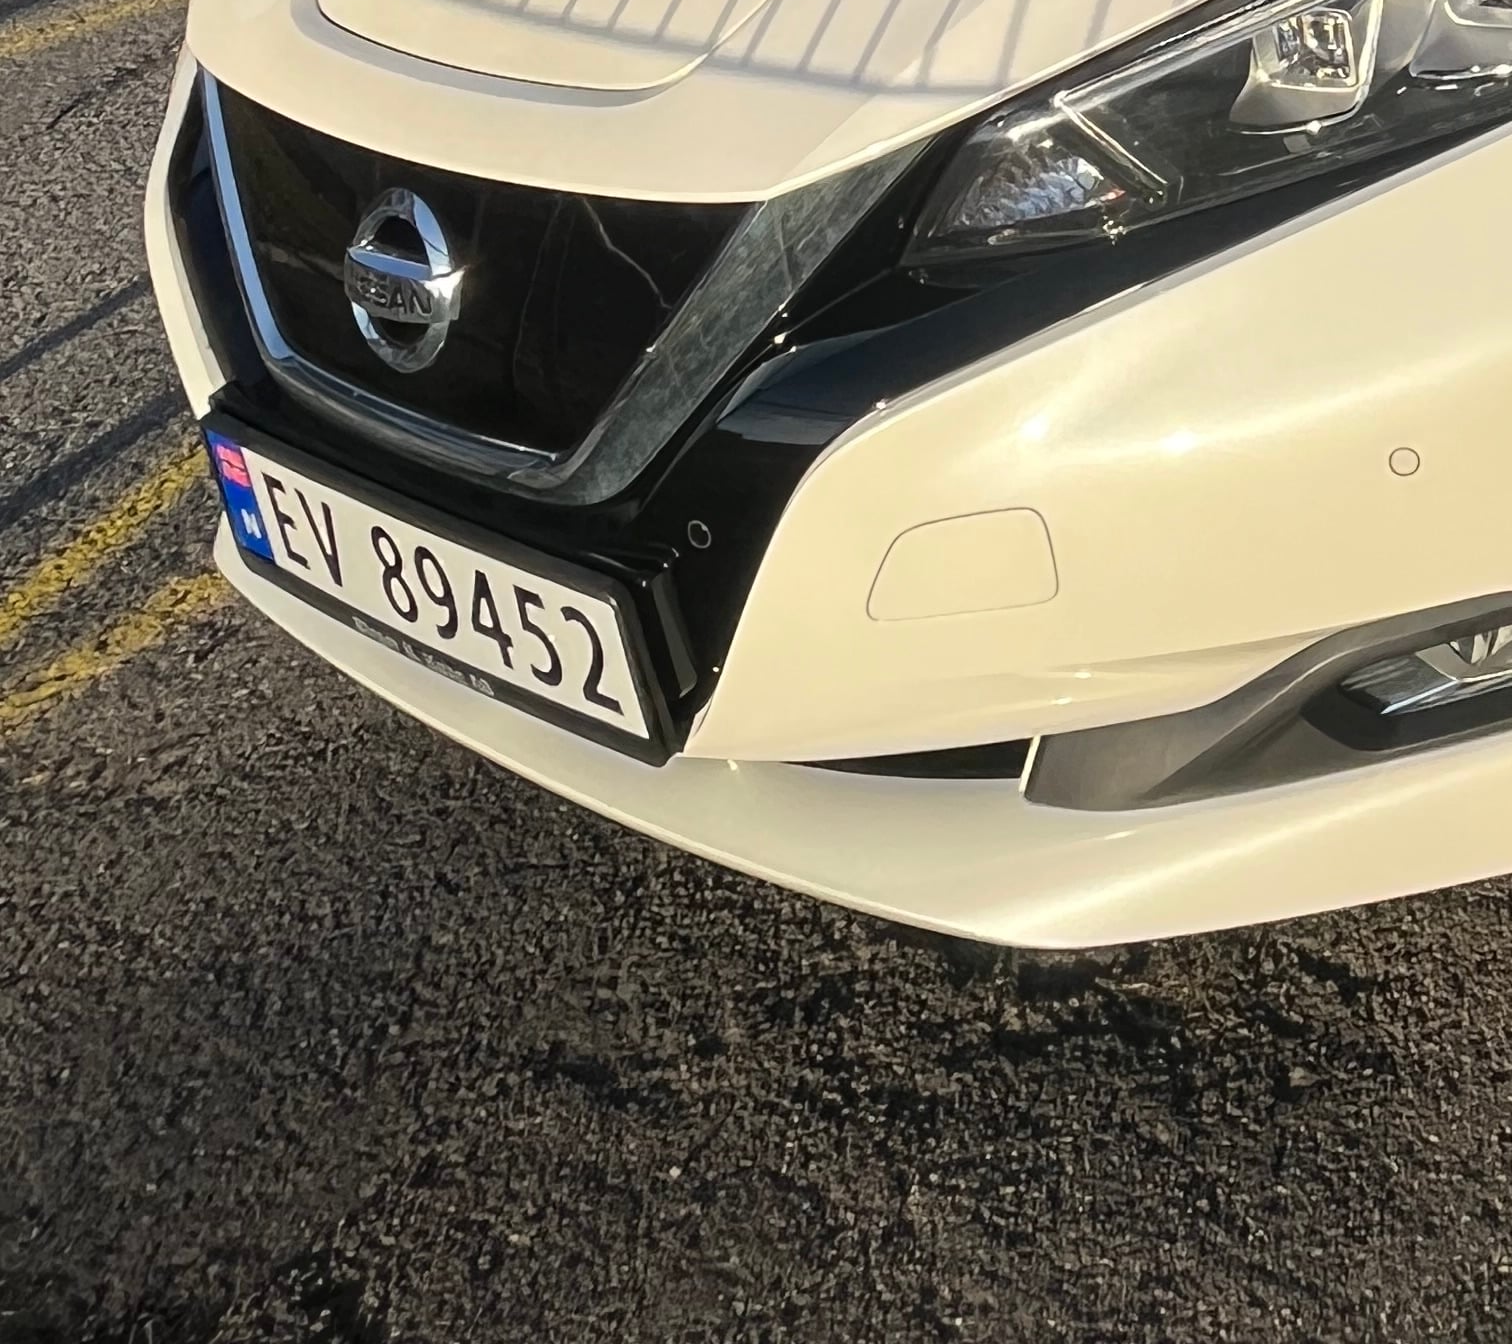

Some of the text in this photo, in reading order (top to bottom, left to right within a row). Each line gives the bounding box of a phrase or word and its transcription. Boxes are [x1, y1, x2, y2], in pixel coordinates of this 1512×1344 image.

[240, 507, 262, 540] N
[260, 470, 344, 588] EV
[369, 524, 625, 717] 89452
